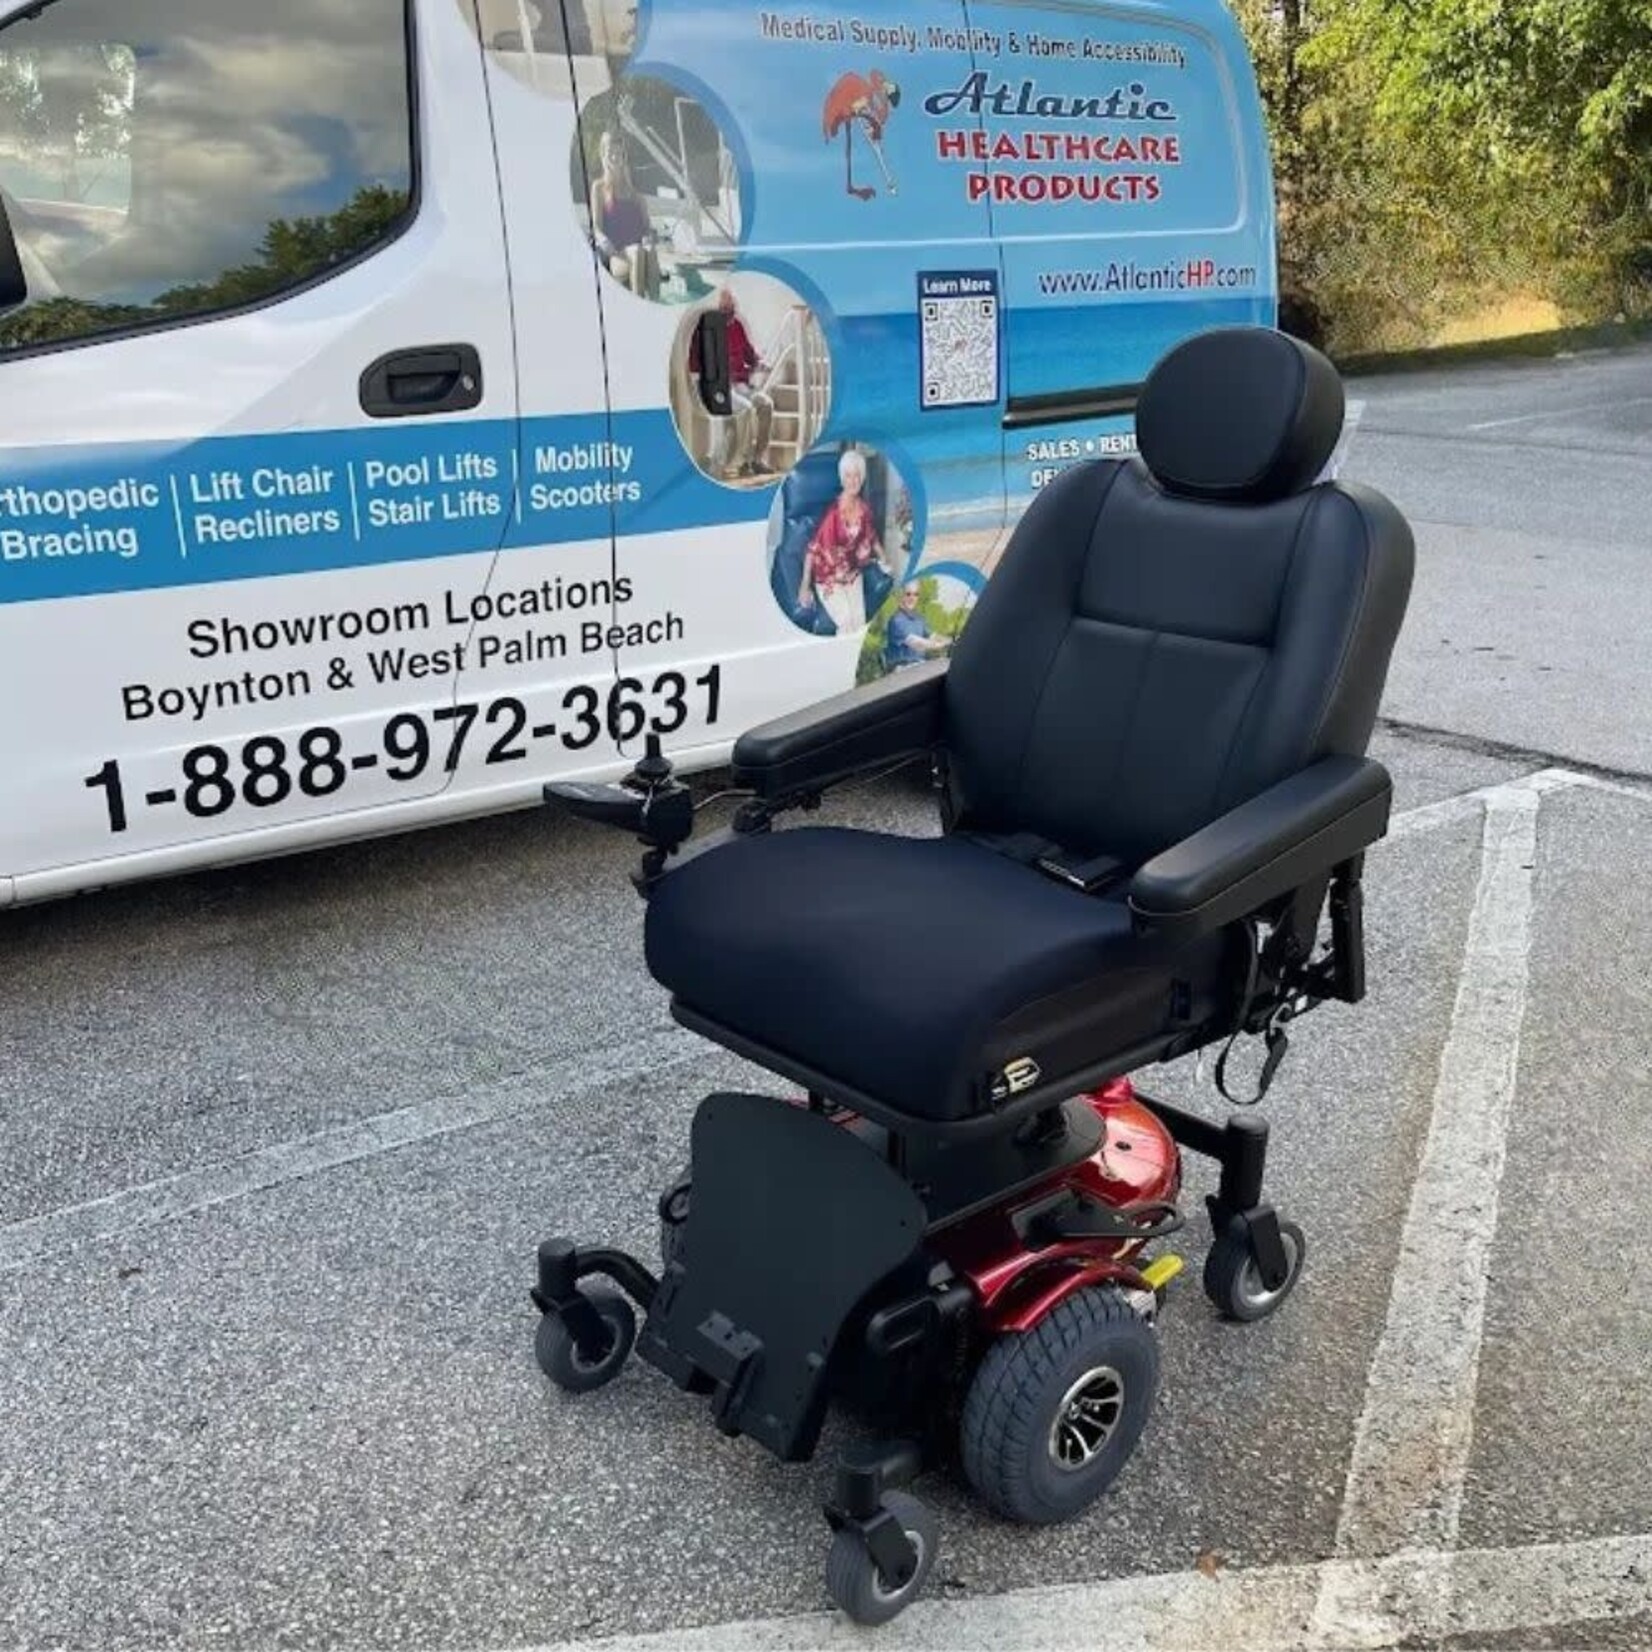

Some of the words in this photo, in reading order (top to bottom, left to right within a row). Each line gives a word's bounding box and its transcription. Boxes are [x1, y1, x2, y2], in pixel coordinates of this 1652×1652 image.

[761, 12, 845, 41] Medical
[926, 27, 1000, 57] Mobility
[1009, 33, 1020, 54] &
[1028, 37, 1076, 58] Home
[1082, 37, 1187, 68] Accessibility
[925, 71, 1177, 121] Atlantic
[937, 130, 1180, 162] HEALTHCARE
[967, 173, 1160, 202] PRODUCTS
[923, 277, 957, 294] Learn
[960, 276, 992, 292] More
[1038, 260, 1257, 295] www.AtlanticHP.com
[534, 441, 634, 475] Mobility
[1027, 438, 1080, 461] SALES
[1100, 433, 1138, 454] RENT
[189, 471, 244, 503] Lift
[251, 464, 334, 498] Chair
[365, 456, 429, 489] Pool
[438, 452, 498, 483] Lifts
[368, 497, 434, 527] Stair
[442, 490, 502, 520] Lifts
[530, 480, 641, 511] Scooters
[0, 523, 138, 561] Bracing
[194, 509, 341, 544] Recliners
[187, 596, 430, 659] Showroom
[444, 576, 635, 625] Locations
[121, 668, 312, 722] Boynton
[327, 658, 354, 692] &
[368, 643, 465, 686] West
[478, 629, 567, 669] Palm
[580, 611, 684, 653] Beach
[83, 663, 725, 834] 1-888-972-3631
